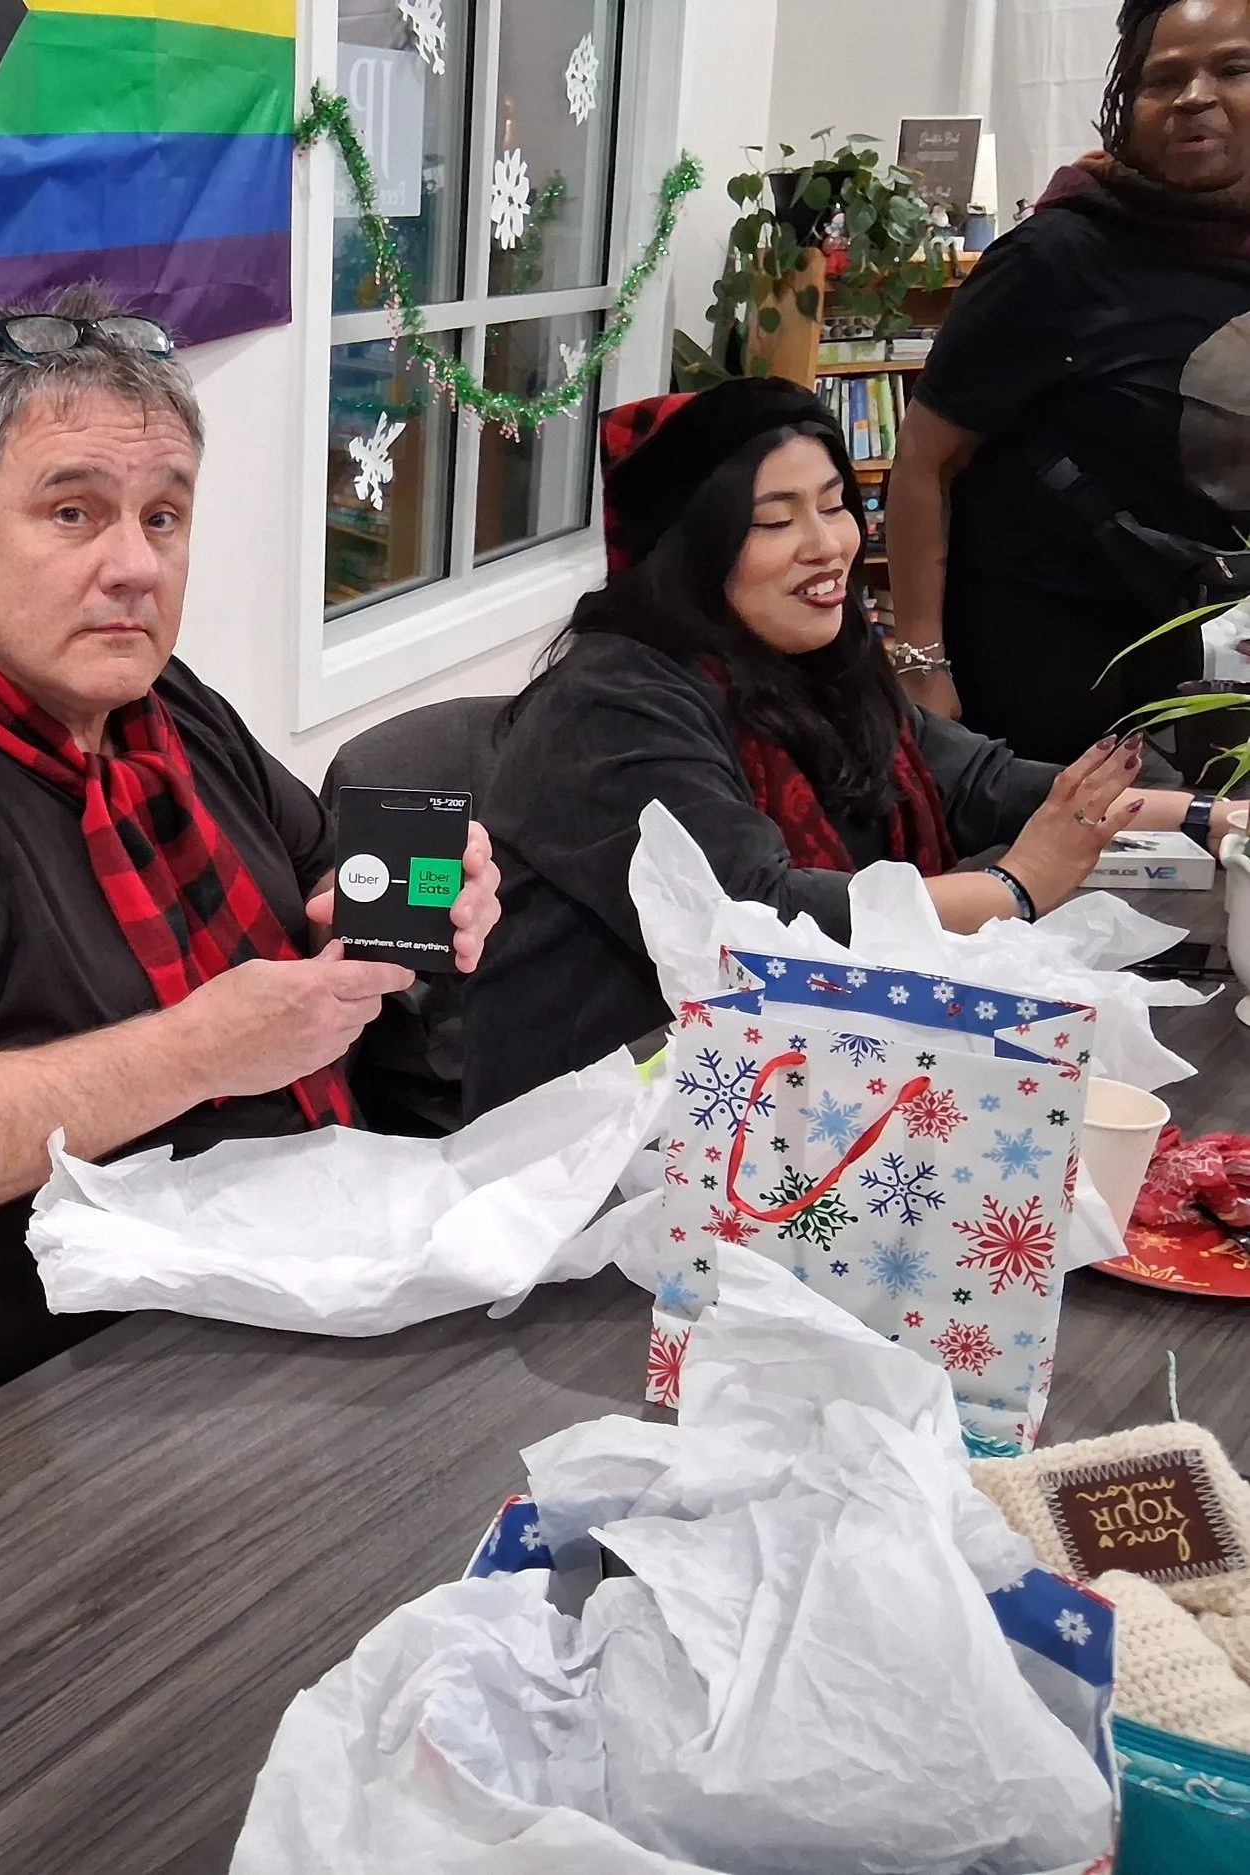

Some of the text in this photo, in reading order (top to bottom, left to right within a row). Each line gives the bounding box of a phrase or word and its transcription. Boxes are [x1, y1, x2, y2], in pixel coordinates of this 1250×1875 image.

[348, 872, 380, 885] Uber
[419, 871, 451, 882] Uber
[418, 884, 450, 895] Eats
[340, 936, 353, 944] Go
[354, 938, 395, 947] anywhere.
[396, 940, 412, 949] Get
[1089, 1496, 1185, 1532] YOUR
[1117, 1518, 1190, 1562] love
